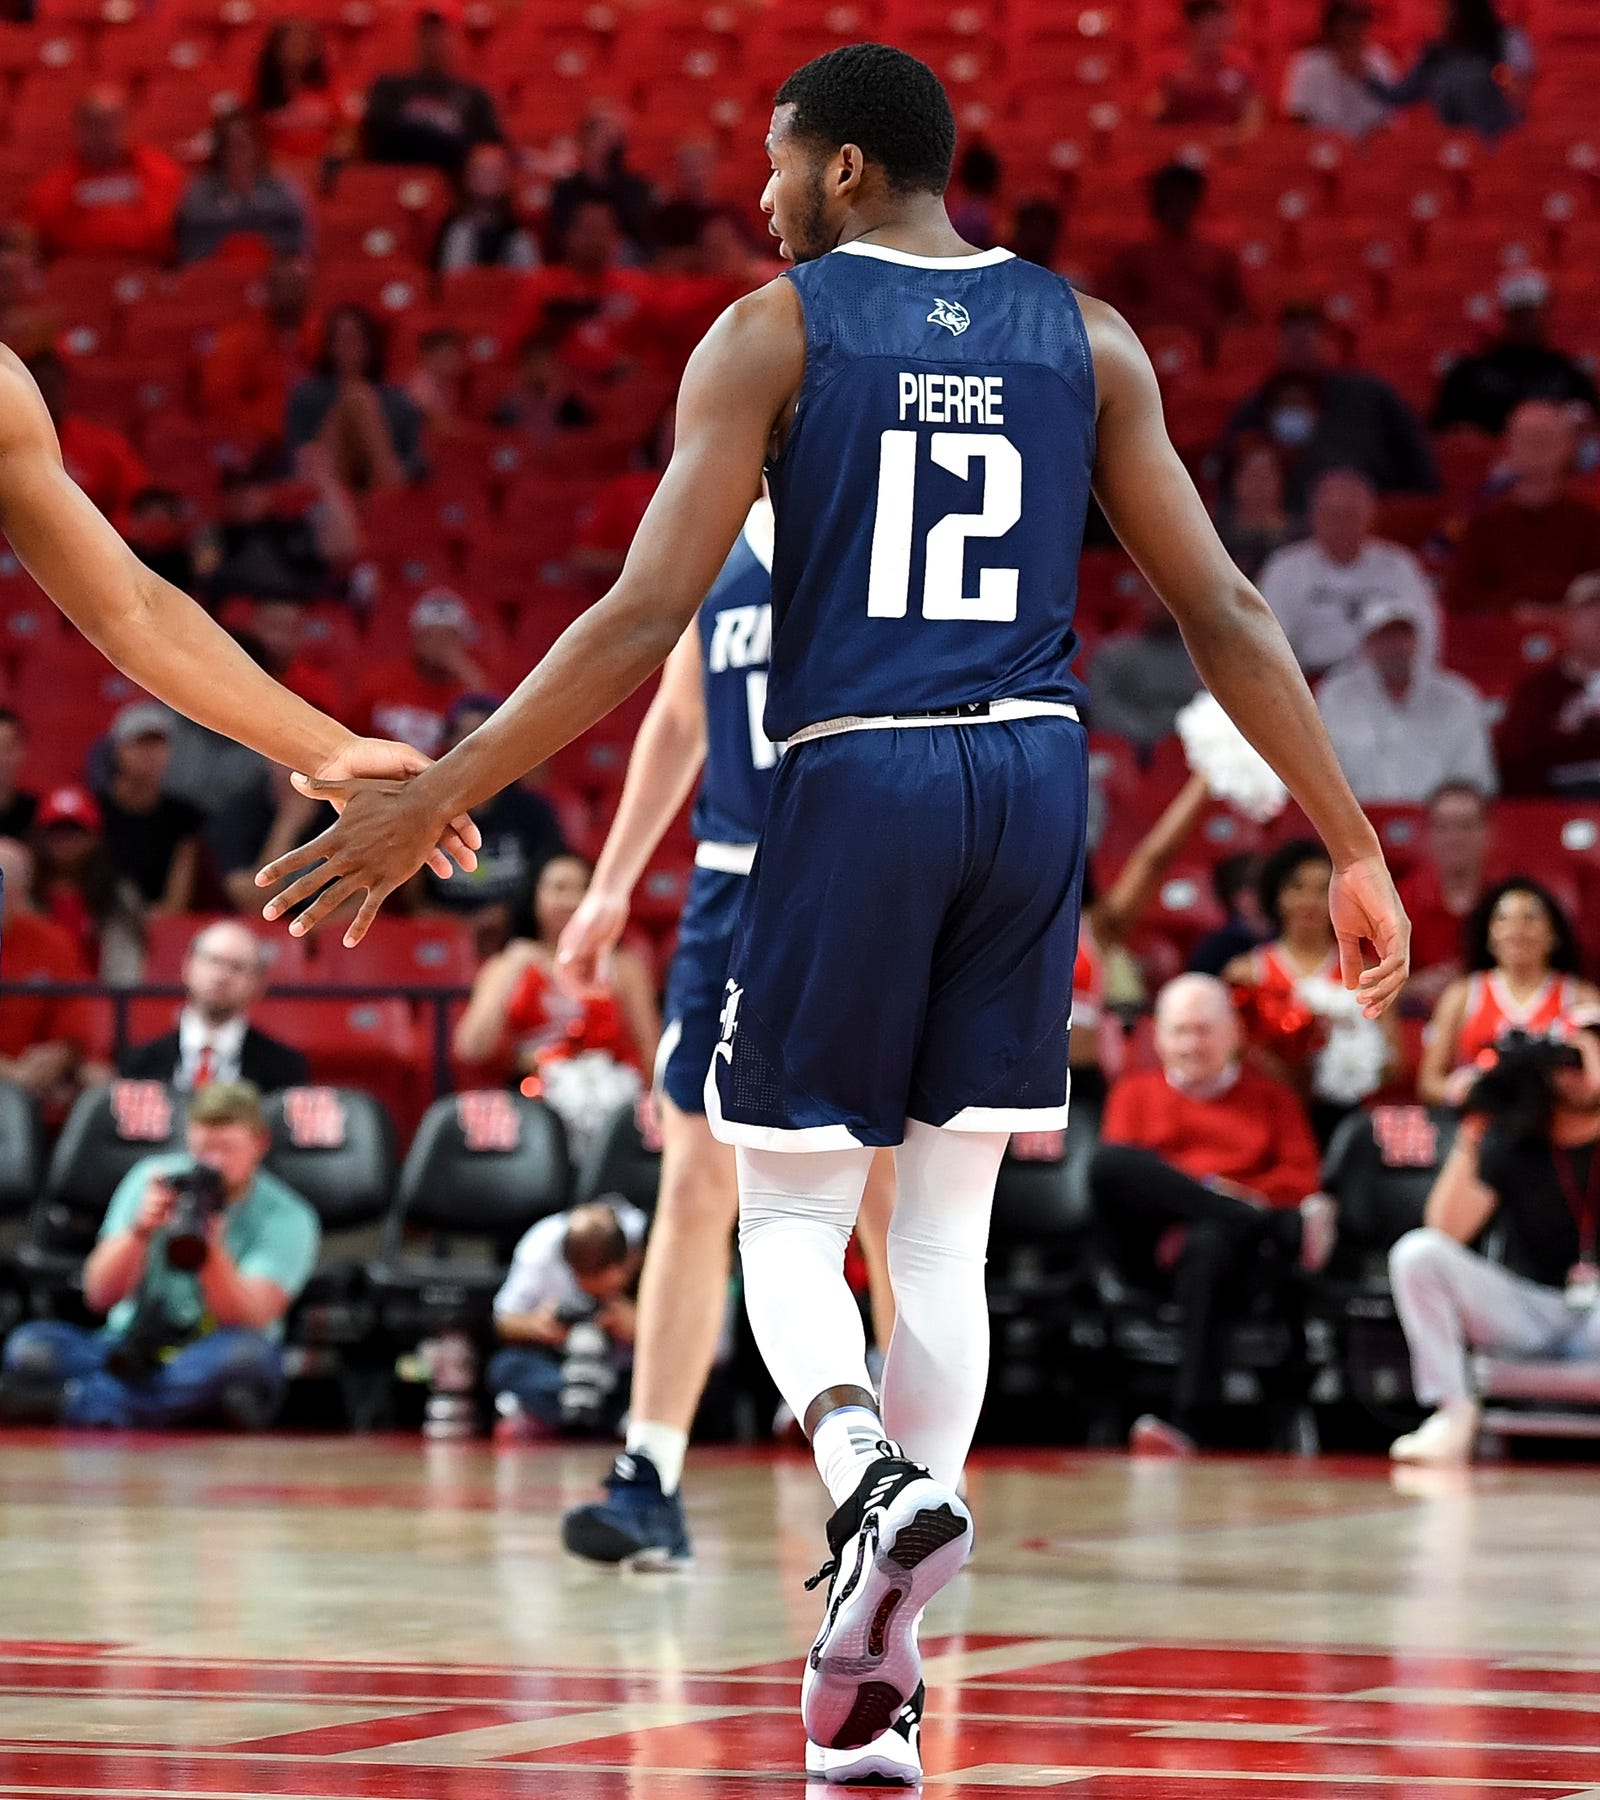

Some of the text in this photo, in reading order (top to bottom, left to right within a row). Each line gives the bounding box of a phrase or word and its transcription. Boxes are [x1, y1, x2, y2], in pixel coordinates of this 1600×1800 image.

[898, 372, 1004, 425] PIERRE
[867, 429, 1022, 622] 12
[709, 603, 772, 673] RI
[746, 670, 787, 770] 1
